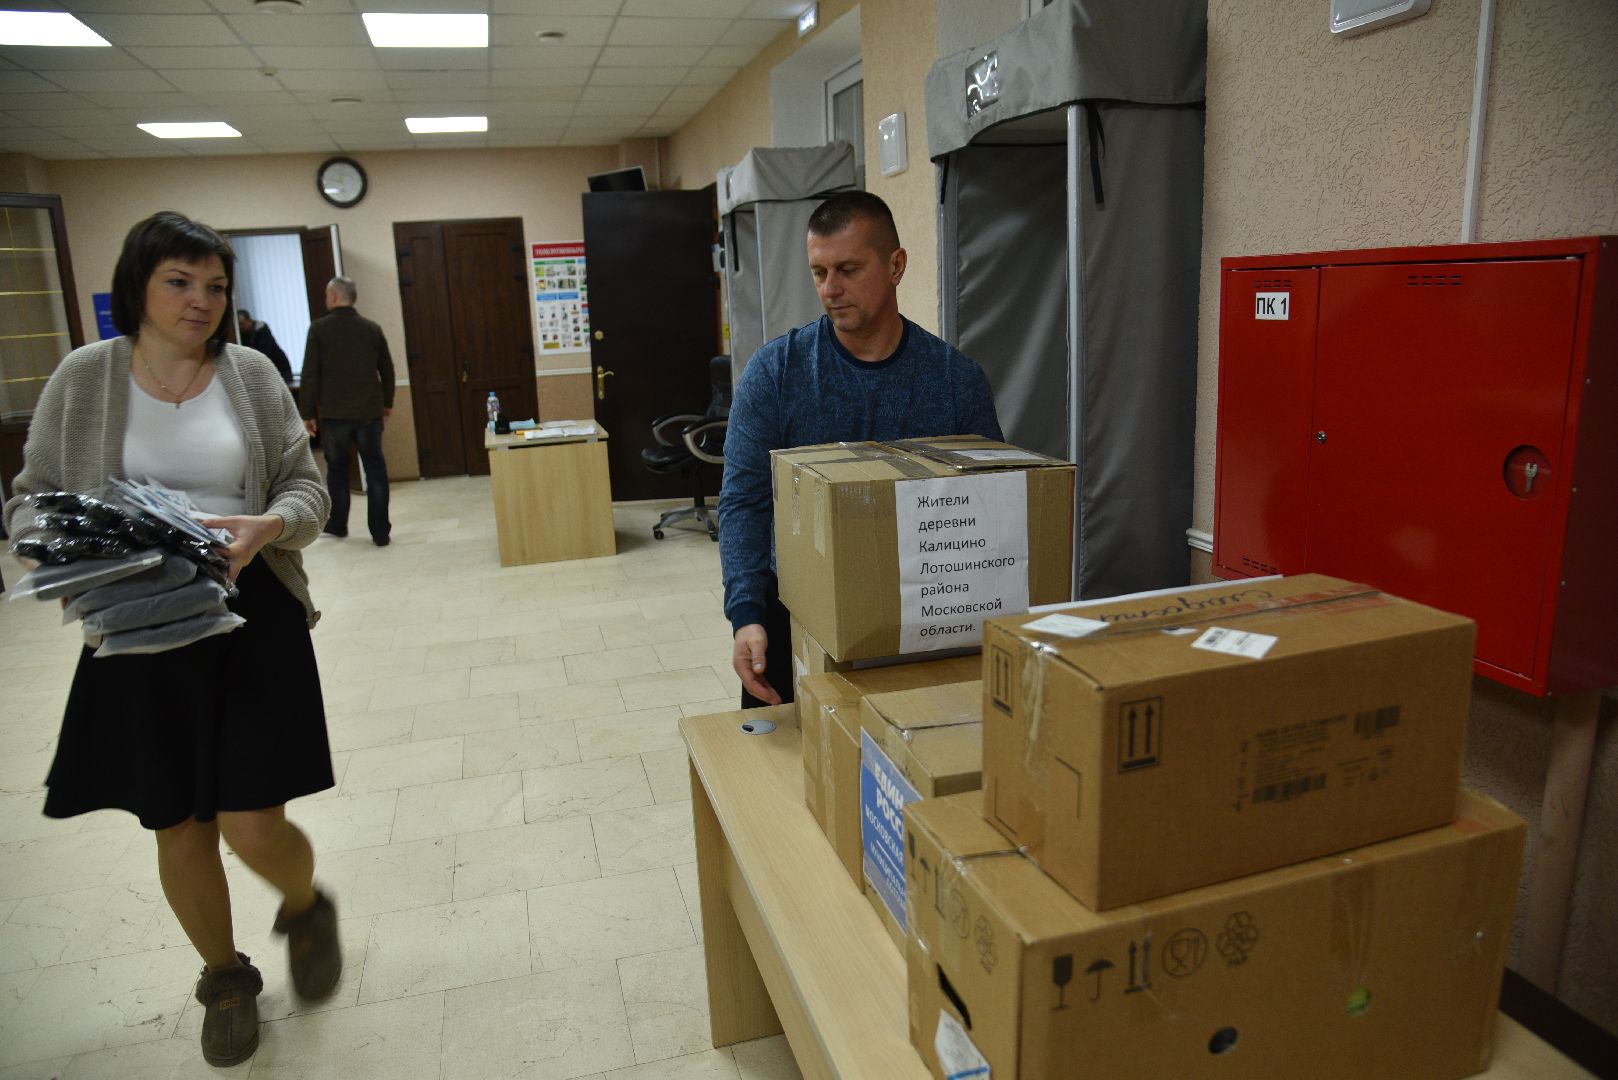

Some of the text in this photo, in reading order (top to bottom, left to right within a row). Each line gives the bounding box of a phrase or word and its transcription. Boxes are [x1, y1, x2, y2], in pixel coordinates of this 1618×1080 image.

[1256, 297, 1287, 315] ПК 1
[917, 494, 970, 509] Жители
[918, 517, 976, 533] деревни
[919, 538, 986, 553] Калицино
[919, 556, 1016, 575] Лотошинского
[920, 582, 970, 599] района
[921, 598, 1002, 618] Московской
[920, 623, 976, 637] области.
[874, 762, 904, 813] ЕДИН
